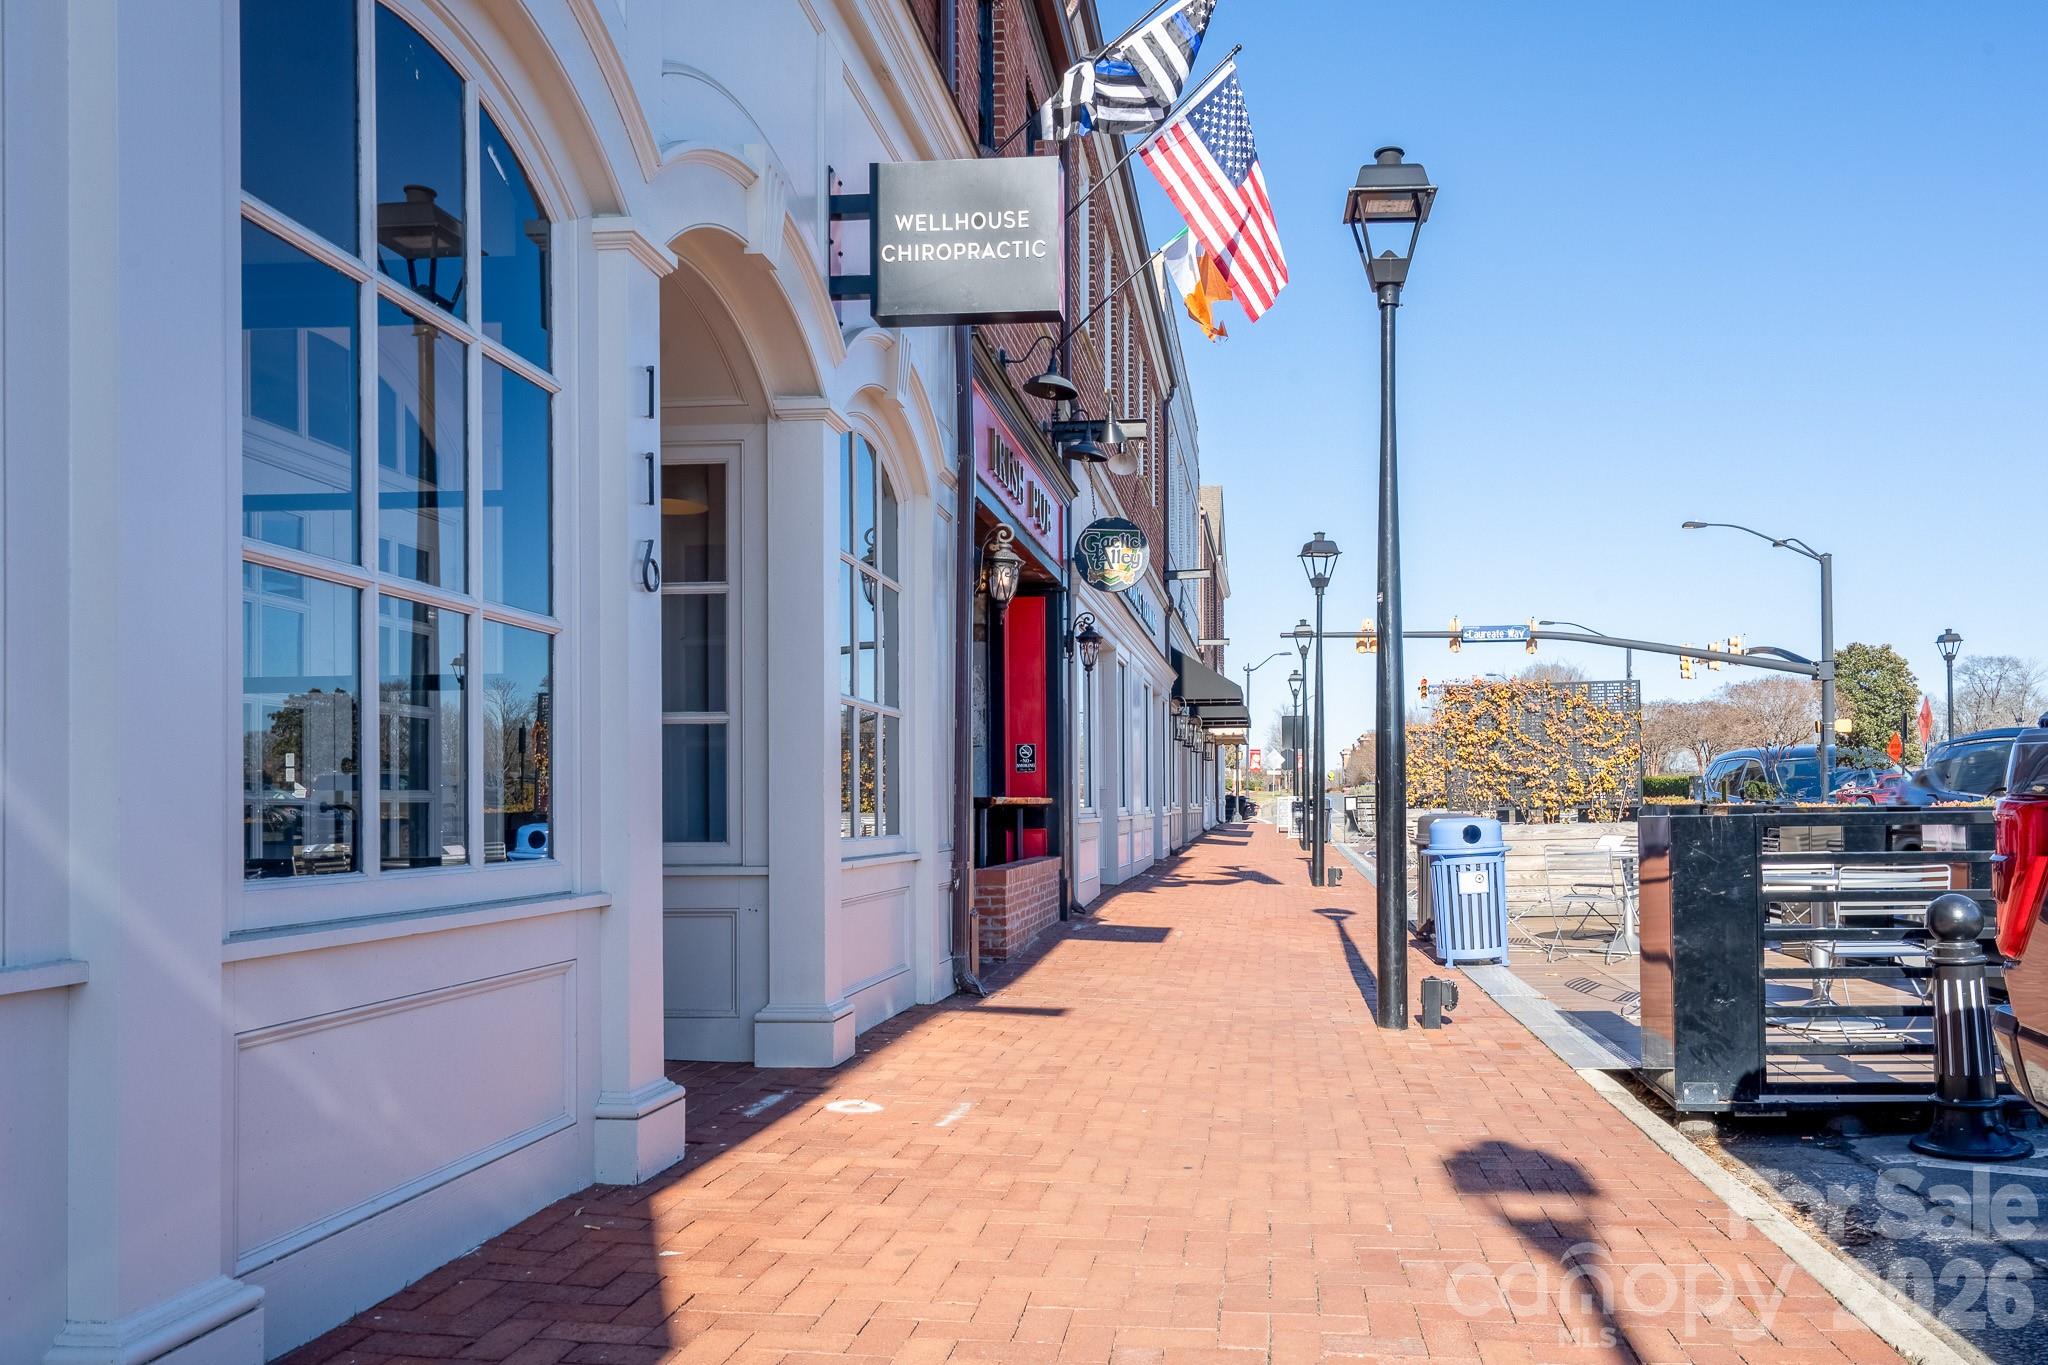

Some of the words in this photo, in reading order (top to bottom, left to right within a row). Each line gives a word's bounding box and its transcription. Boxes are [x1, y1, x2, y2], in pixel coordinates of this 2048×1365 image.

[895, 211, 1030, 232] WELLHOUSE
[881, 240, 1047, 263] CHIROPRACTIC
[987, 428, 1024, 506] IRISH
[1081, 532, 1140, 554] Gaelic
[1092, 547, 1141, 570] Alley
[1469, 629, 1504, 639] Laureate
[1508, 628, 1525, 639] Way
